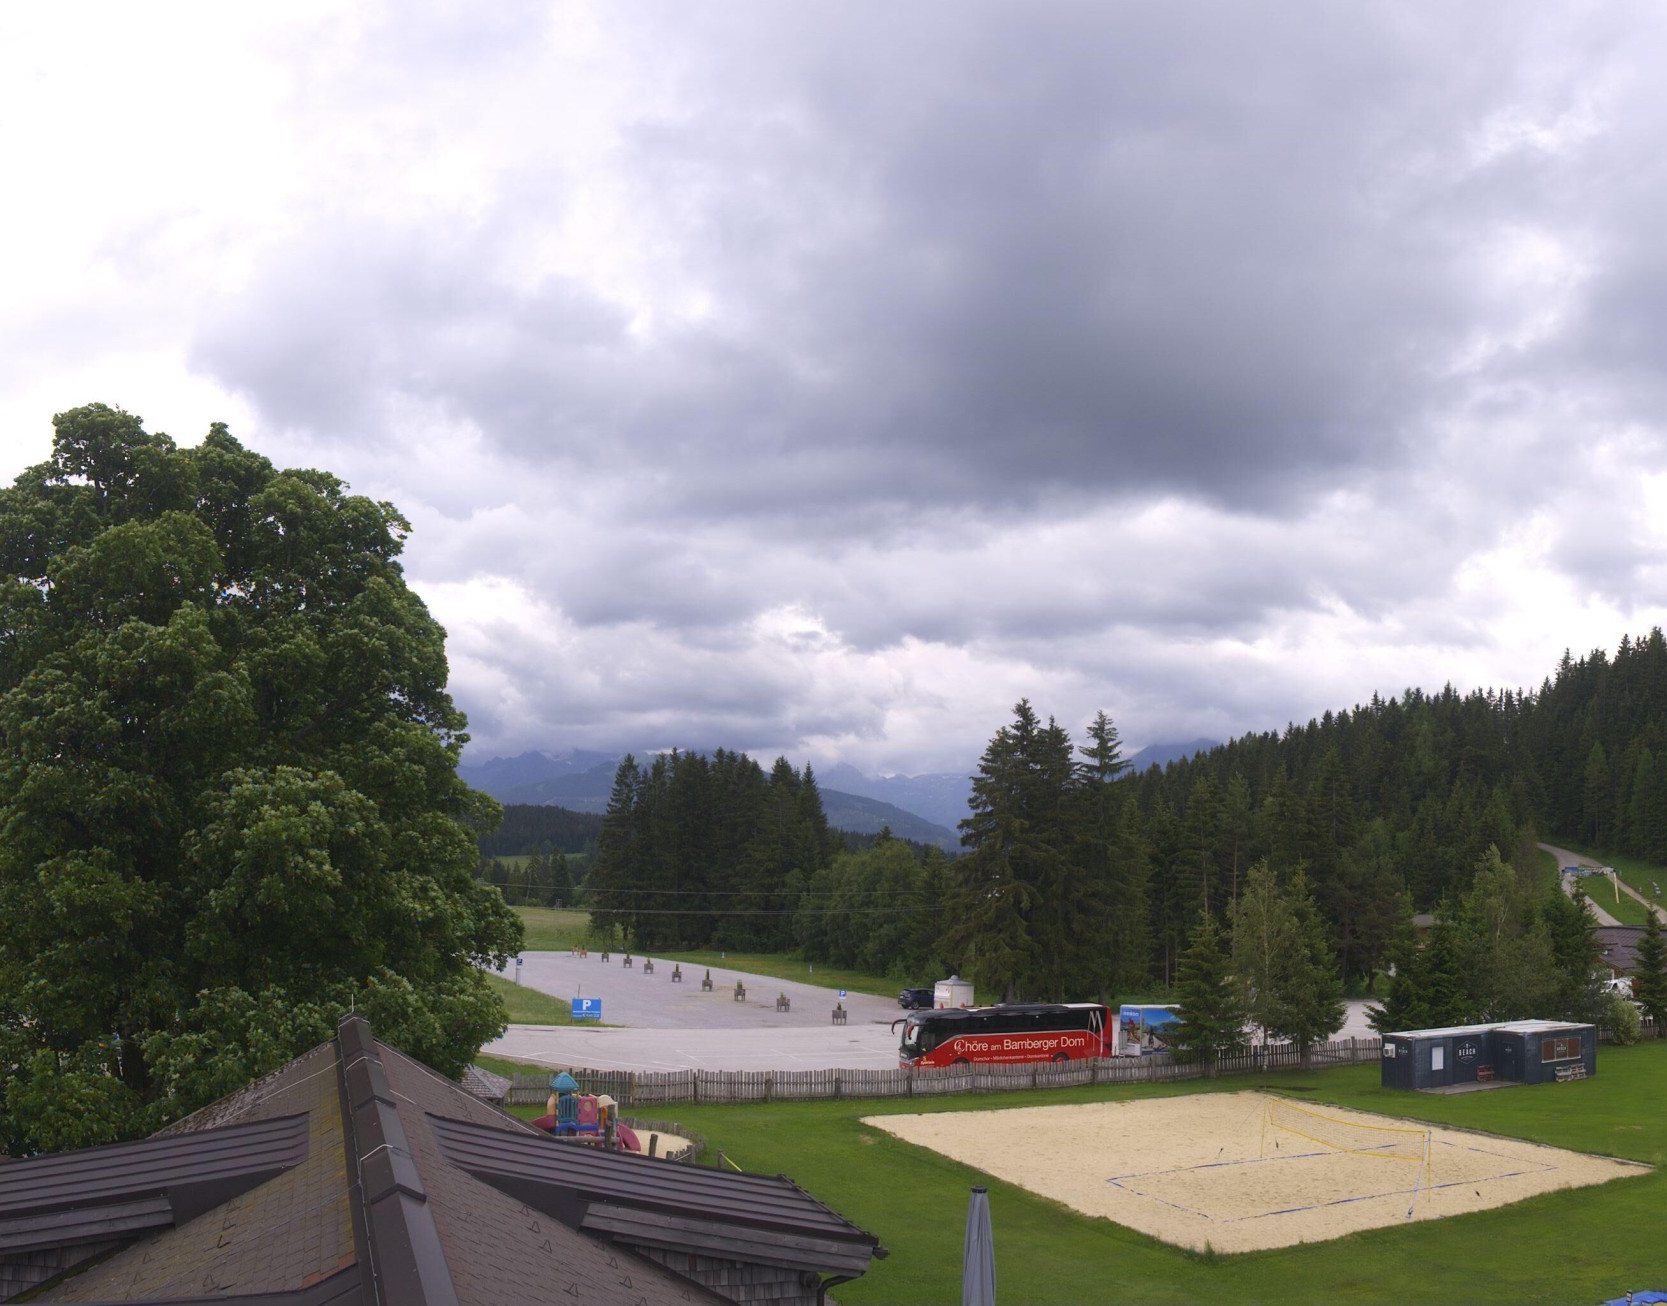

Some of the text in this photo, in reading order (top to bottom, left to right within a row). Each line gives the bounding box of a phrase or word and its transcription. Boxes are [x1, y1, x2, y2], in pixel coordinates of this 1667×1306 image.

[582, 999, 592, 1011] P
[954, 1039, 988, 1053] Chöre
[1003, 1038, 1058, 1051] Bamberger
[1060, 1036, 1085, 1048] Dom
[1458, 1048, 1476, 1056] BEACH
